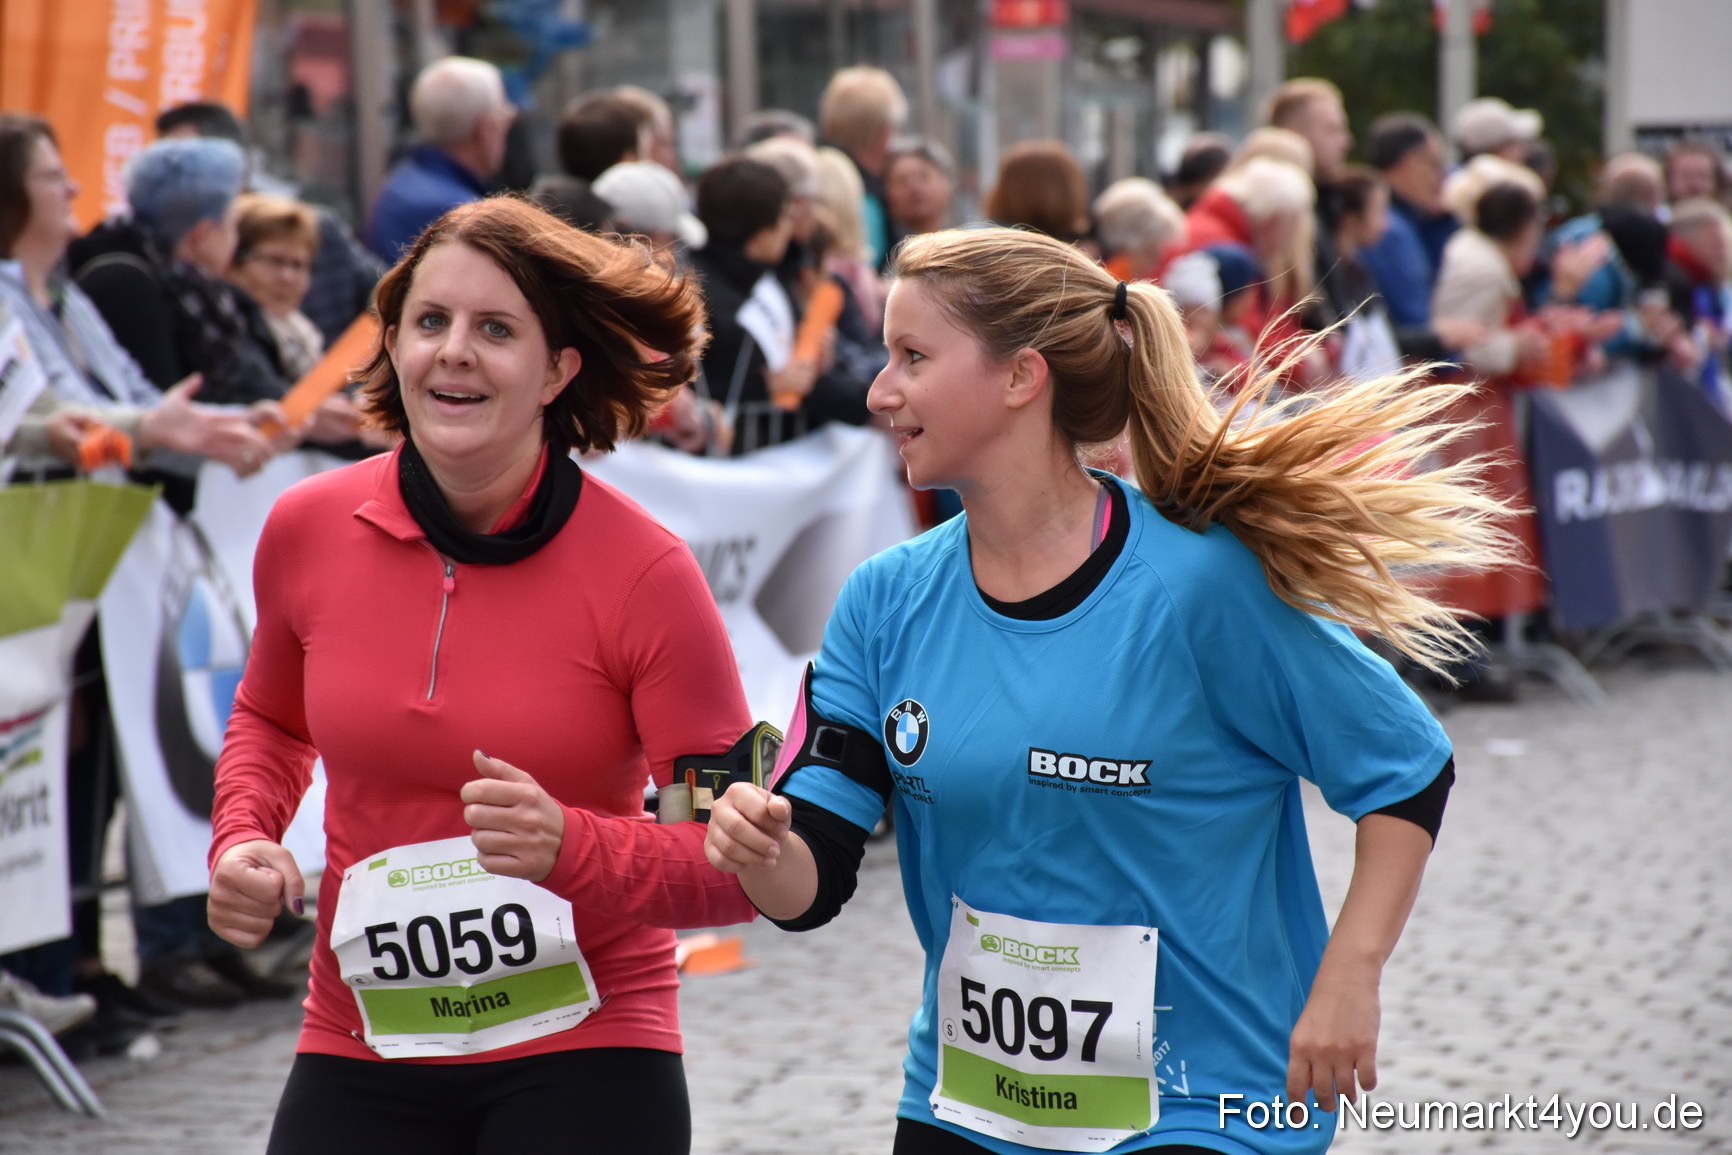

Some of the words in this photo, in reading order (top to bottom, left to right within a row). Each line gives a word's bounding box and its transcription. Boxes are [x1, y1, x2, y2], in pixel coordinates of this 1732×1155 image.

[1028, 747, 1153, 787] BOCK
[1028, 776, 1063, 789] inspired
[1066, 782, 1077, 793] by
[1080, 786, 1108, 795] smart
[1111, 788, 1152, 797] concepts
[412, 883, 438, 892] inspired
[448, 879, 466, 887] smart
[467, 875, 496, 884] concepts
[364, 903, 537, 981] 5059
[1003, 937, 1080, 965] BOCK
[1003, 957, 1023, 967] inspired
[1024, 961, 1030, 969] by
[430, 991, 510, 1018] Marina
[961, 975, 1113, 1063] 5097
[995, 1074, 1077, 1110] Kristina
